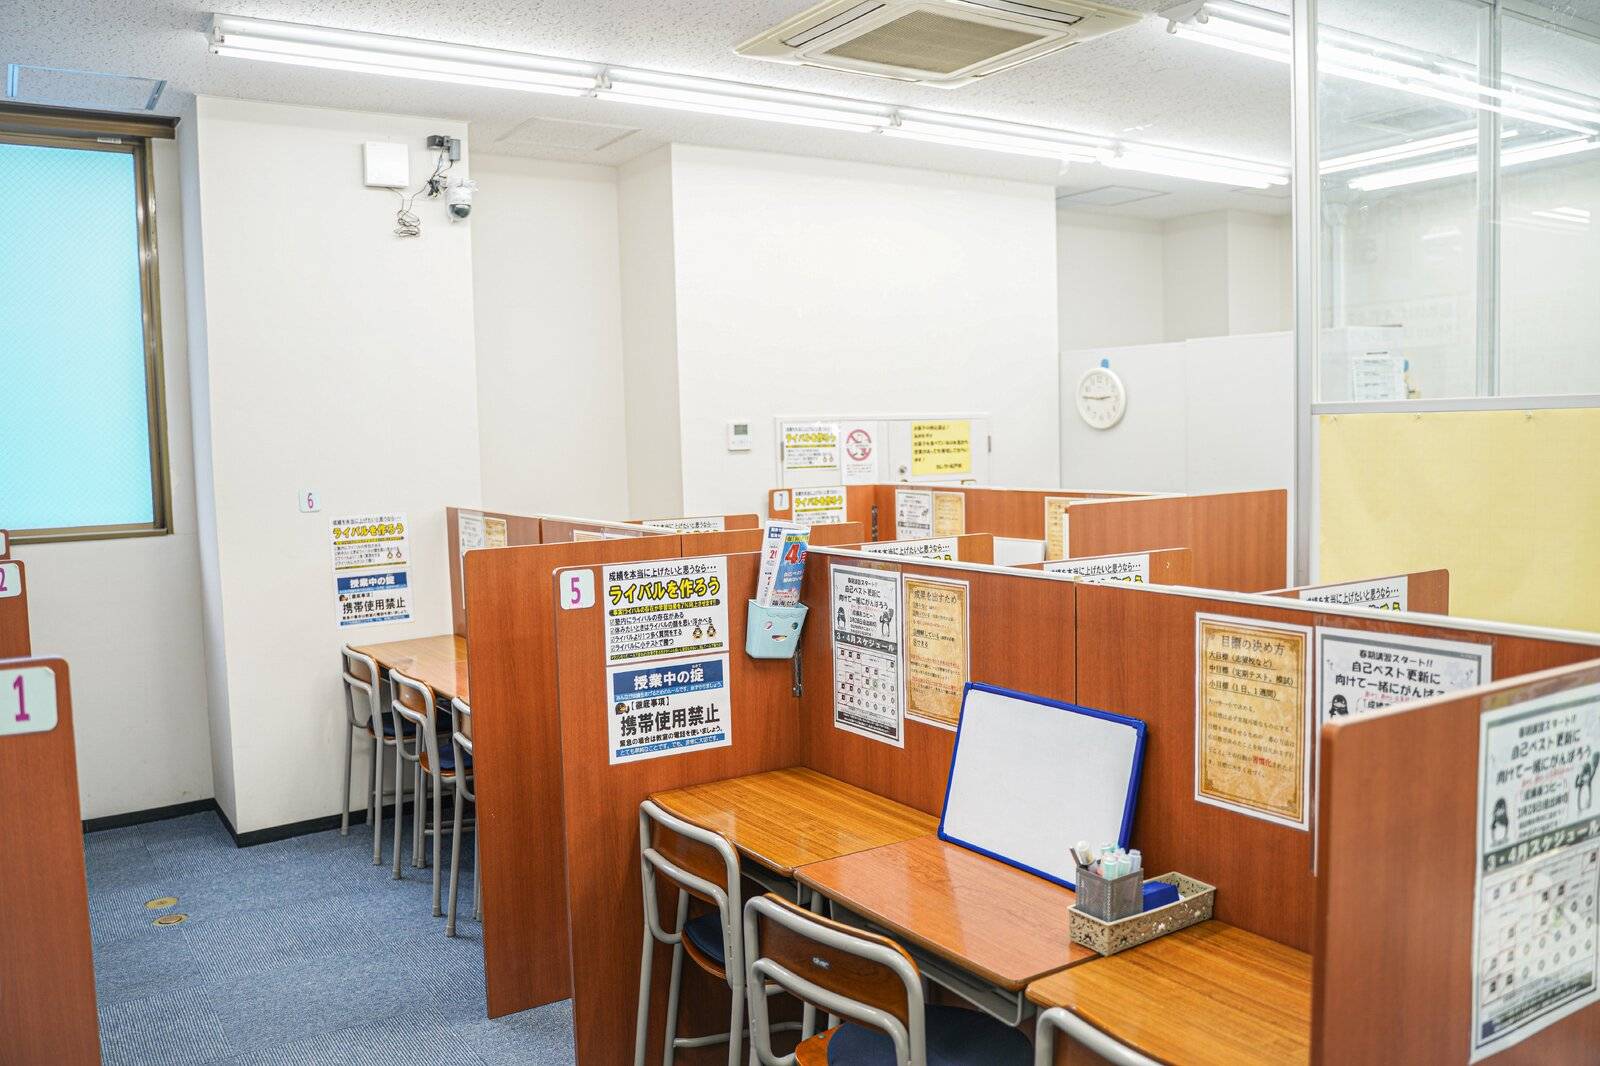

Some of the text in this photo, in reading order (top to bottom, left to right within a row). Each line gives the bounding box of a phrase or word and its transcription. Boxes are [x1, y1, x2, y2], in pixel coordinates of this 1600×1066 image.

[307, 492, 313, 508] 6
[571, 577, 581, 604] 5
[609, 576, 721, 605] ライバルを作ろう
[343, 596, 406, 614] 携帯使用禁止
[1221, 635, 1284, 656] 目標の決め方
[634, 668, 704, 690] 授業中の掟
[1352, 661, 1441, 685] 自己ベスト更新に
[13, 675, 30, 722] 1
[621, 703, 720, 737] 携帯使用禁止
